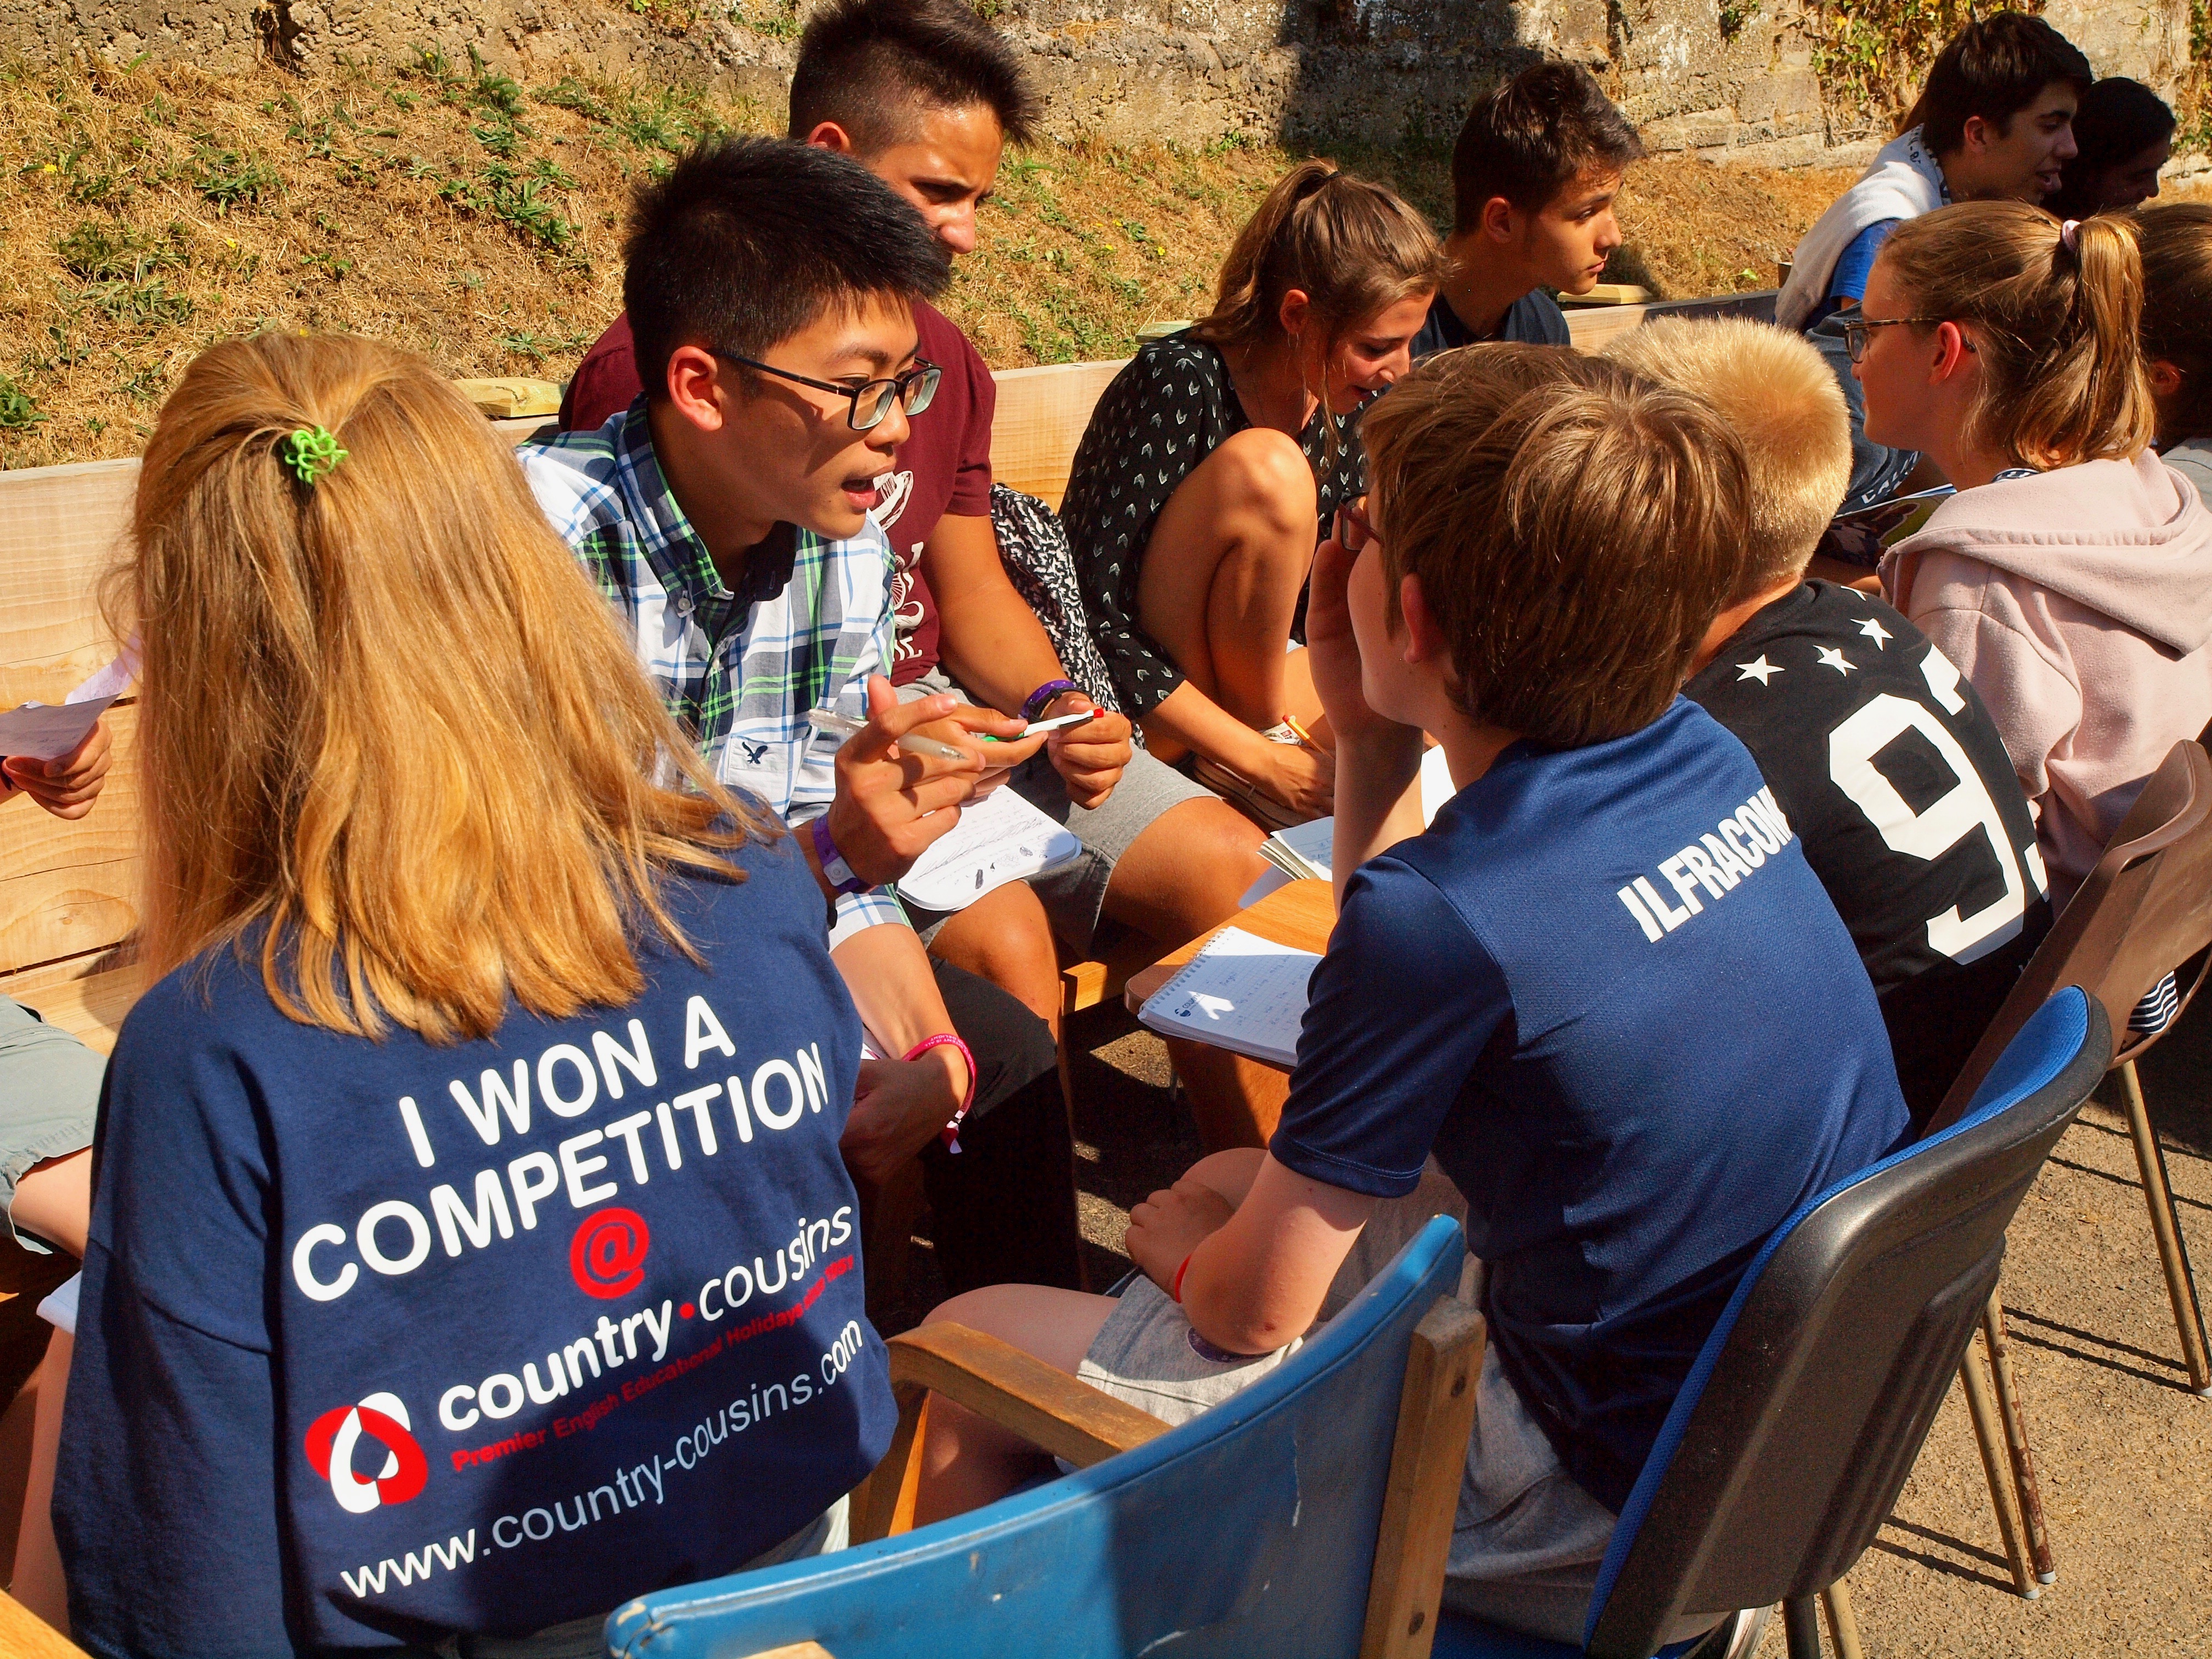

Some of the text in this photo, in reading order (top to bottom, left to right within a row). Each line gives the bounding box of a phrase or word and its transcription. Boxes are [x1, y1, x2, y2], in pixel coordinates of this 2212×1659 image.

[1616, 784, 1793, 944] ILFRACOM
[399, 995, 736, 1168] I WON A
[292, 1042, 828, 1301] COMPETITION
[569, 1207, 650, 1300] @
[340, 1320, 863, 1598] www.country-cousins.com
[451, 1428, 548, 1472] Premier
[552, 1392, 621, 1439] English
[620, 1335, 723, 1403] Educational
[725, 1302, 804, 1346] Holidays
